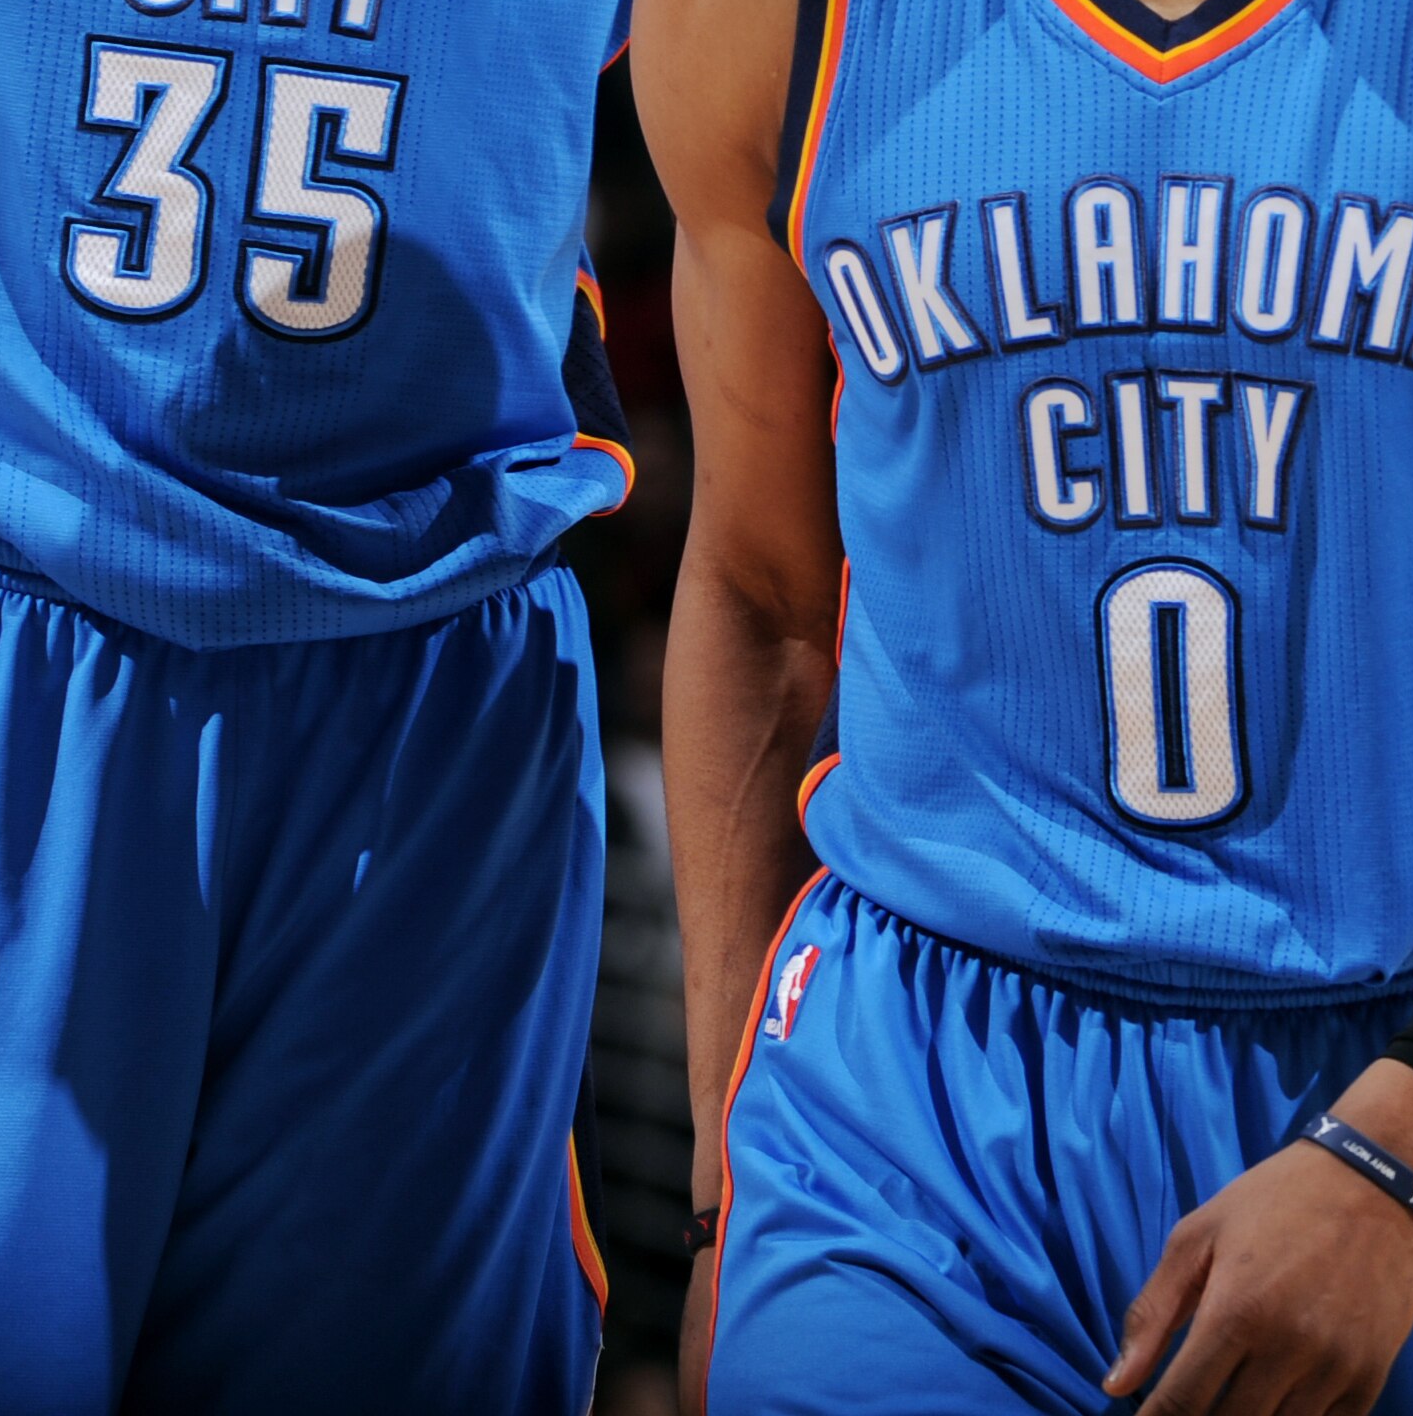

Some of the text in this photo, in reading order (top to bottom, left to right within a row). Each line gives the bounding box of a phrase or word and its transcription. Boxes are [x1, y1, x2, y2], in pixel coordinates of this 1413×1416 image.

[61, 34, 409, 343] 35
[1018, 369, 1312, 533] CITY
[1093, 556, 1253, 833] 0
